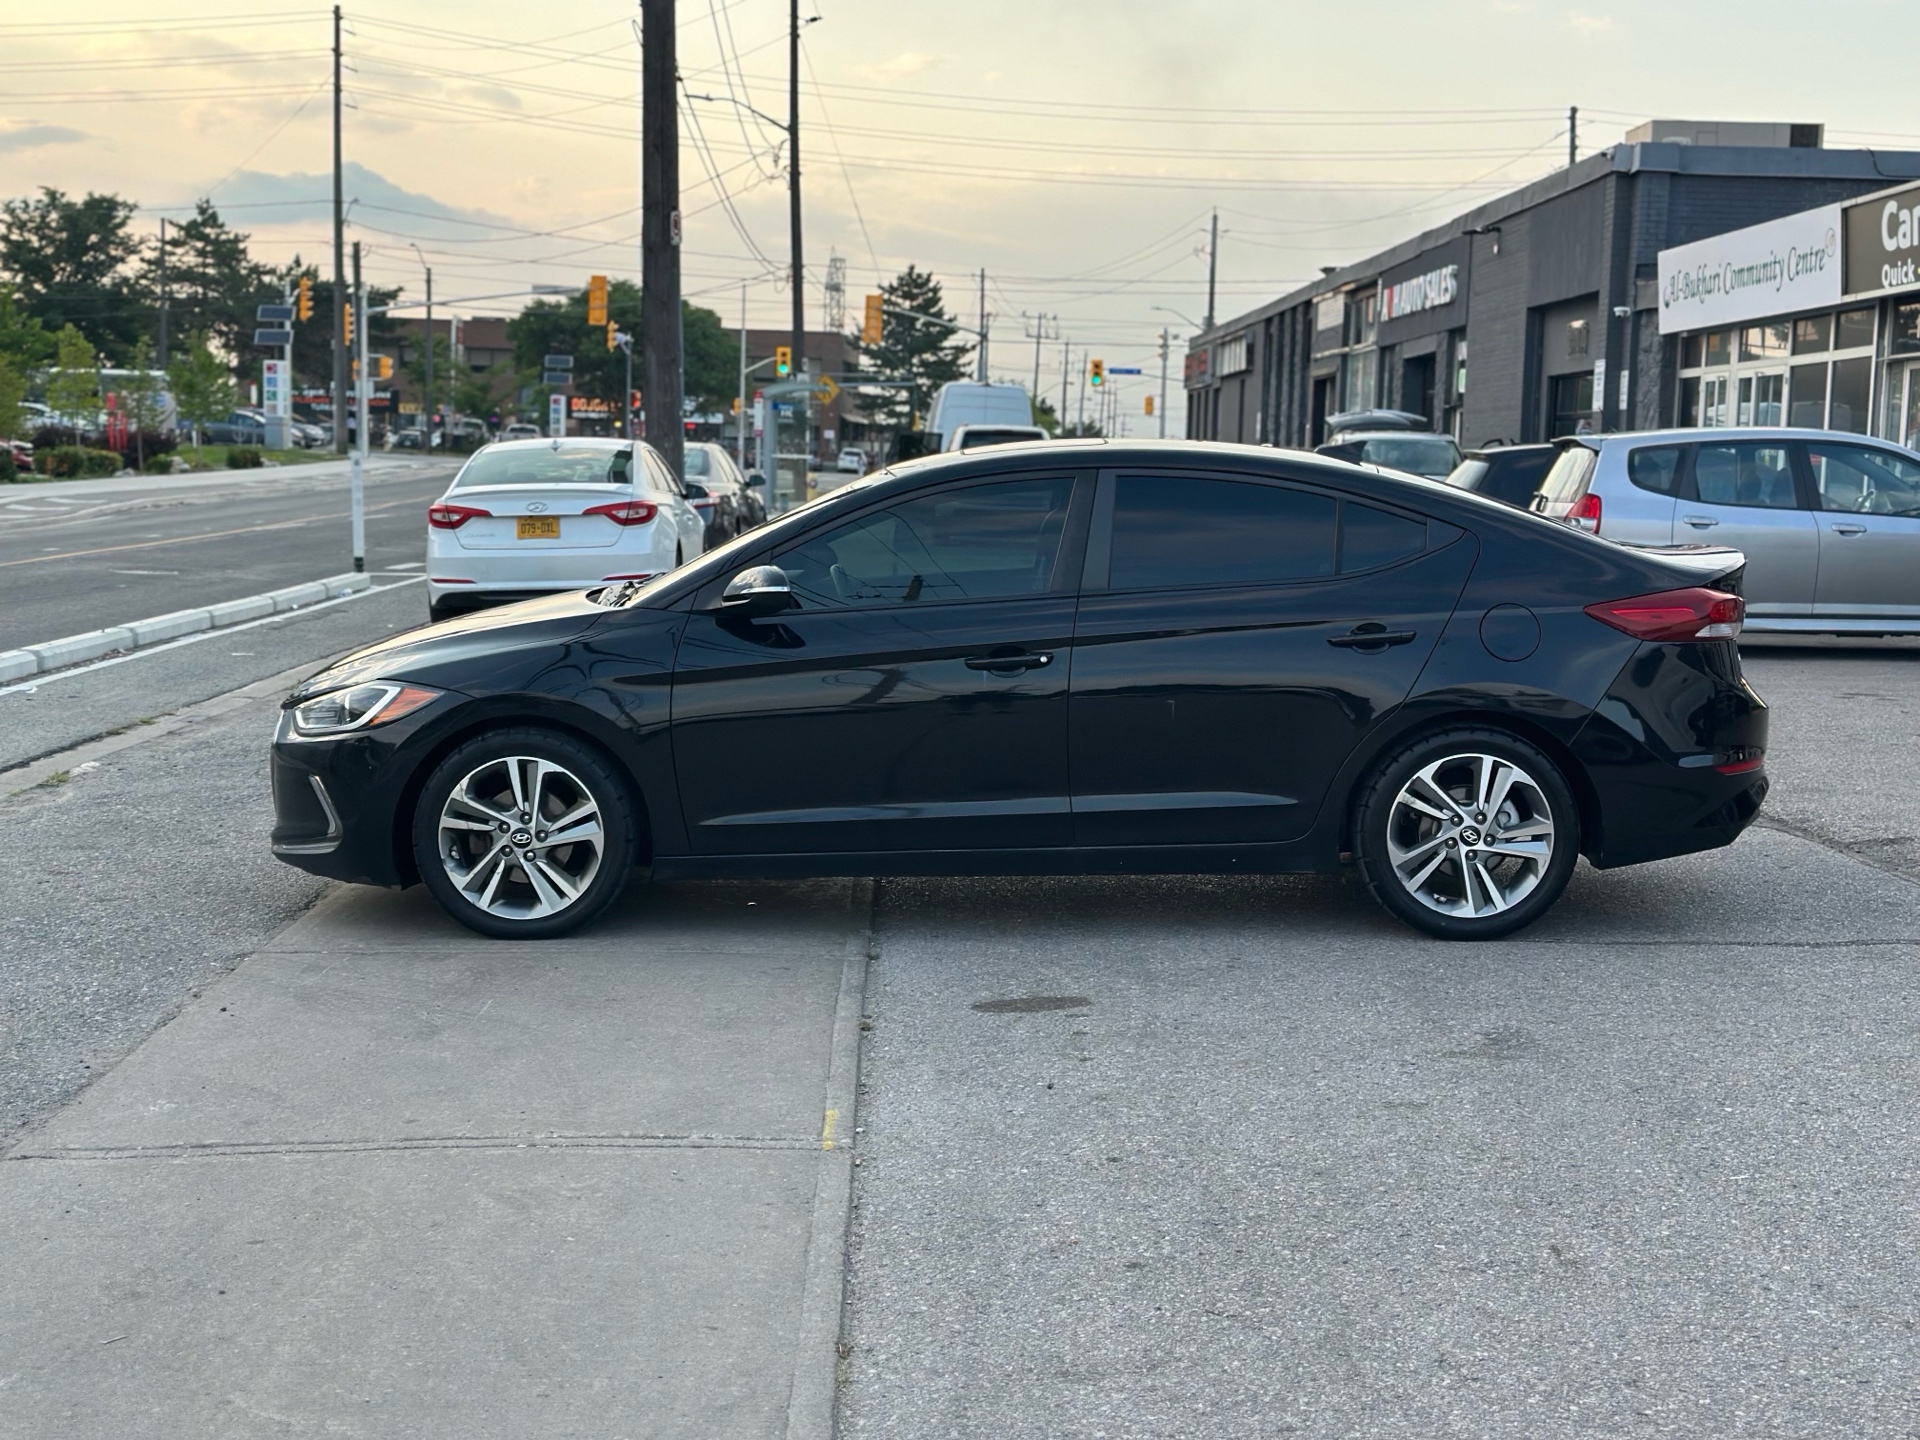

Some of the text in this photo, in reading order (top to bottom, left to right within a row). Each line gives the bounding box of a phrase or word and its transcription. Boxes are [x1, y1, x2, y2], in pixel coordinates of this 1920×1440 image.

[1400, 275, 1425, 317] AUTO
[1425, 264, 1459, 310] SALES
[1667, 246, 1826, 305] Al-Bukhari Community Centre
[1881, 257, 1915, 289] Quick
